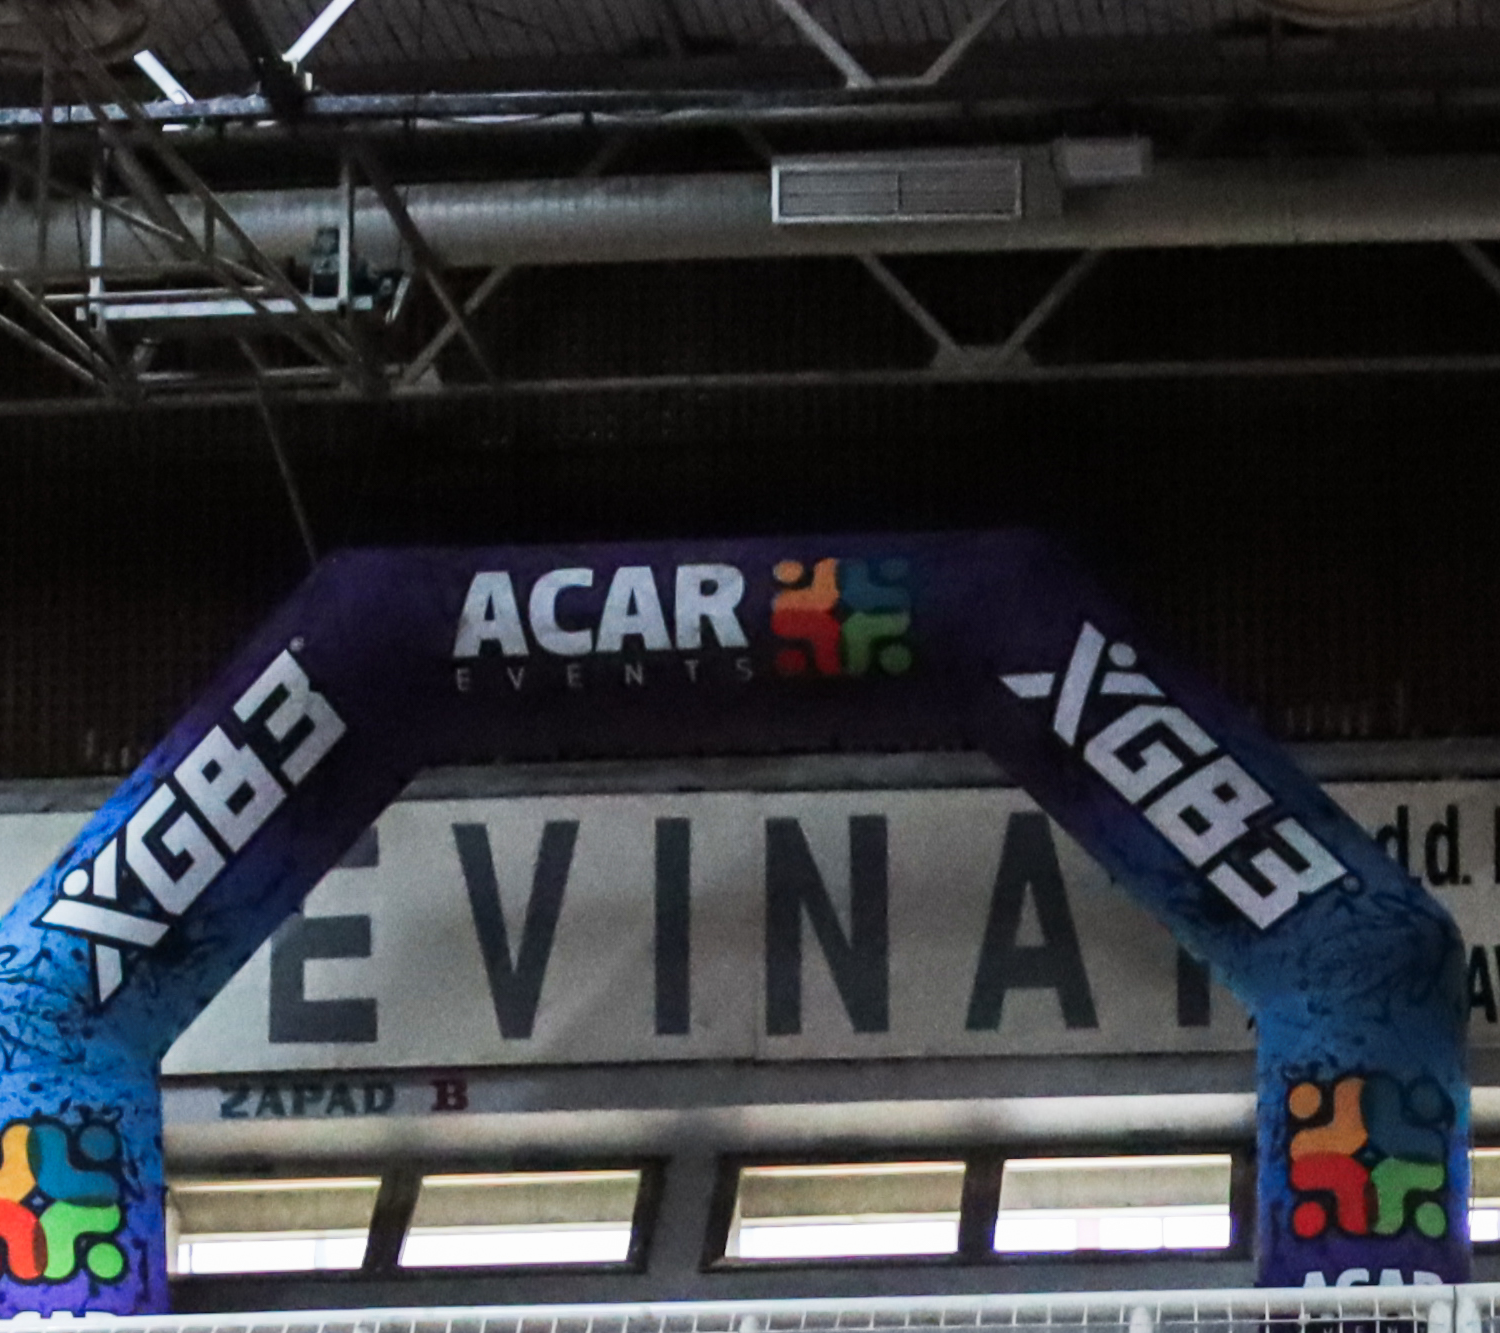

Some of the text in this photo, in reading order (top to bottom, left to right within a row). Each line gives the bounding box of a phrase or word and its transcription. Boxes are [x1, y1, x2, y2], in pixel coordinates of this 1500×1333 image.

[453, 563, 749, 658] ACAR
[454, 658, 755, 692] EVENTS
[218, 1079, 469, 1119] ZAPAD B
